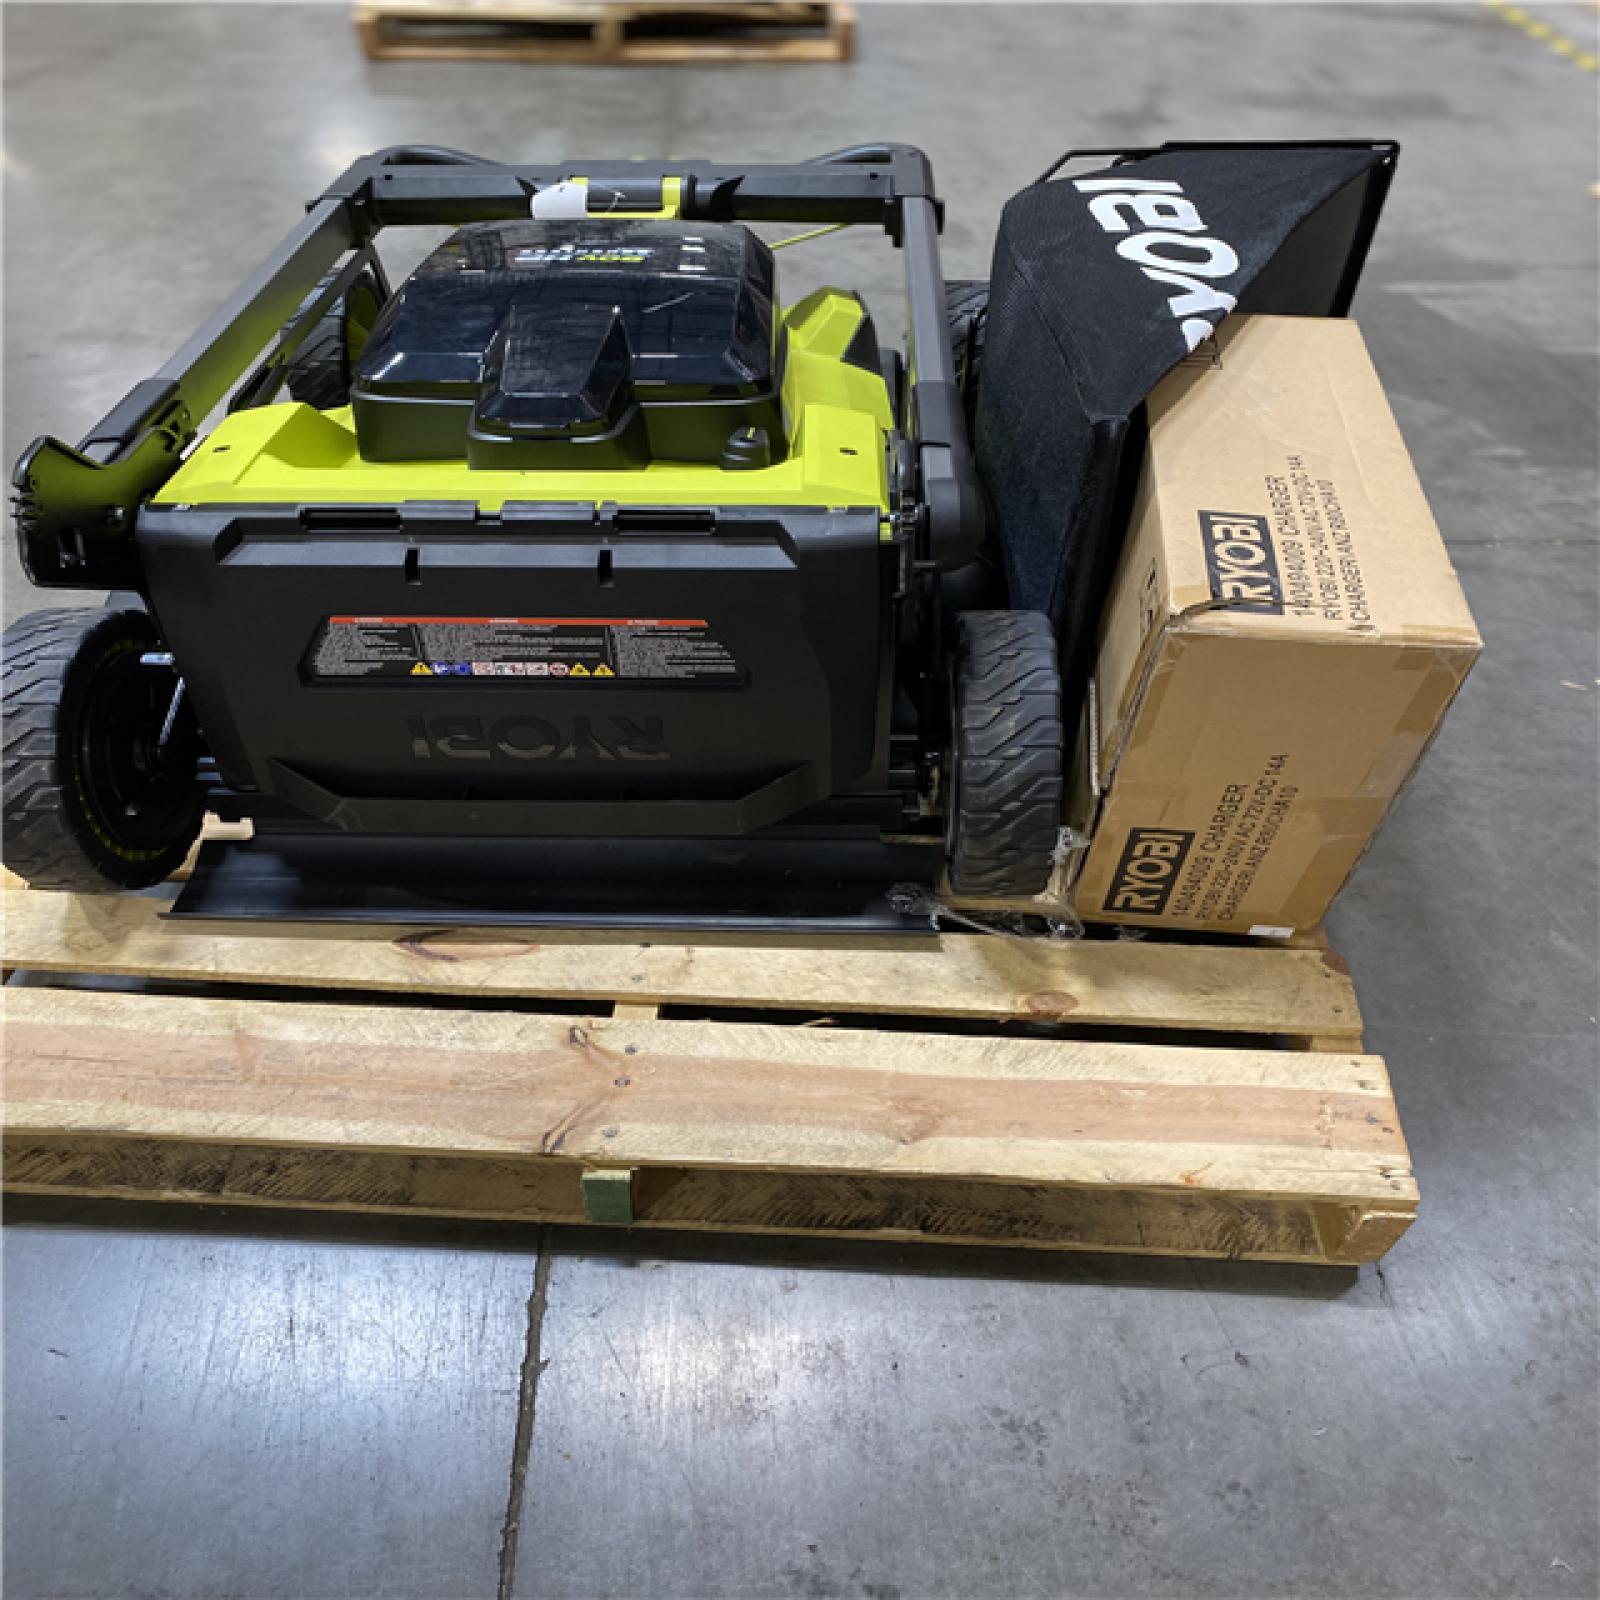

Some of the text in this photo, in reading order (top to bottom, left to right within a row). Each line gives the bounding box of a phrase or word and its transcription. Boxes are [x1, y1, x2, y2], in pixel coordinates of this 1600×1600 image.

[1265, 474, 1300, 535] CHARGER
[1209, 514, 1275, 606] RYOBI
[1318, 579, 1343, 621] RYOBI
[406, 714, 670, 761] RYOBI
[1200, 784, 1248, 851] CHARGER
[1112, 833, 1186, 910] RYOBI
[1195, 889, 1222, 920] RYOBI
